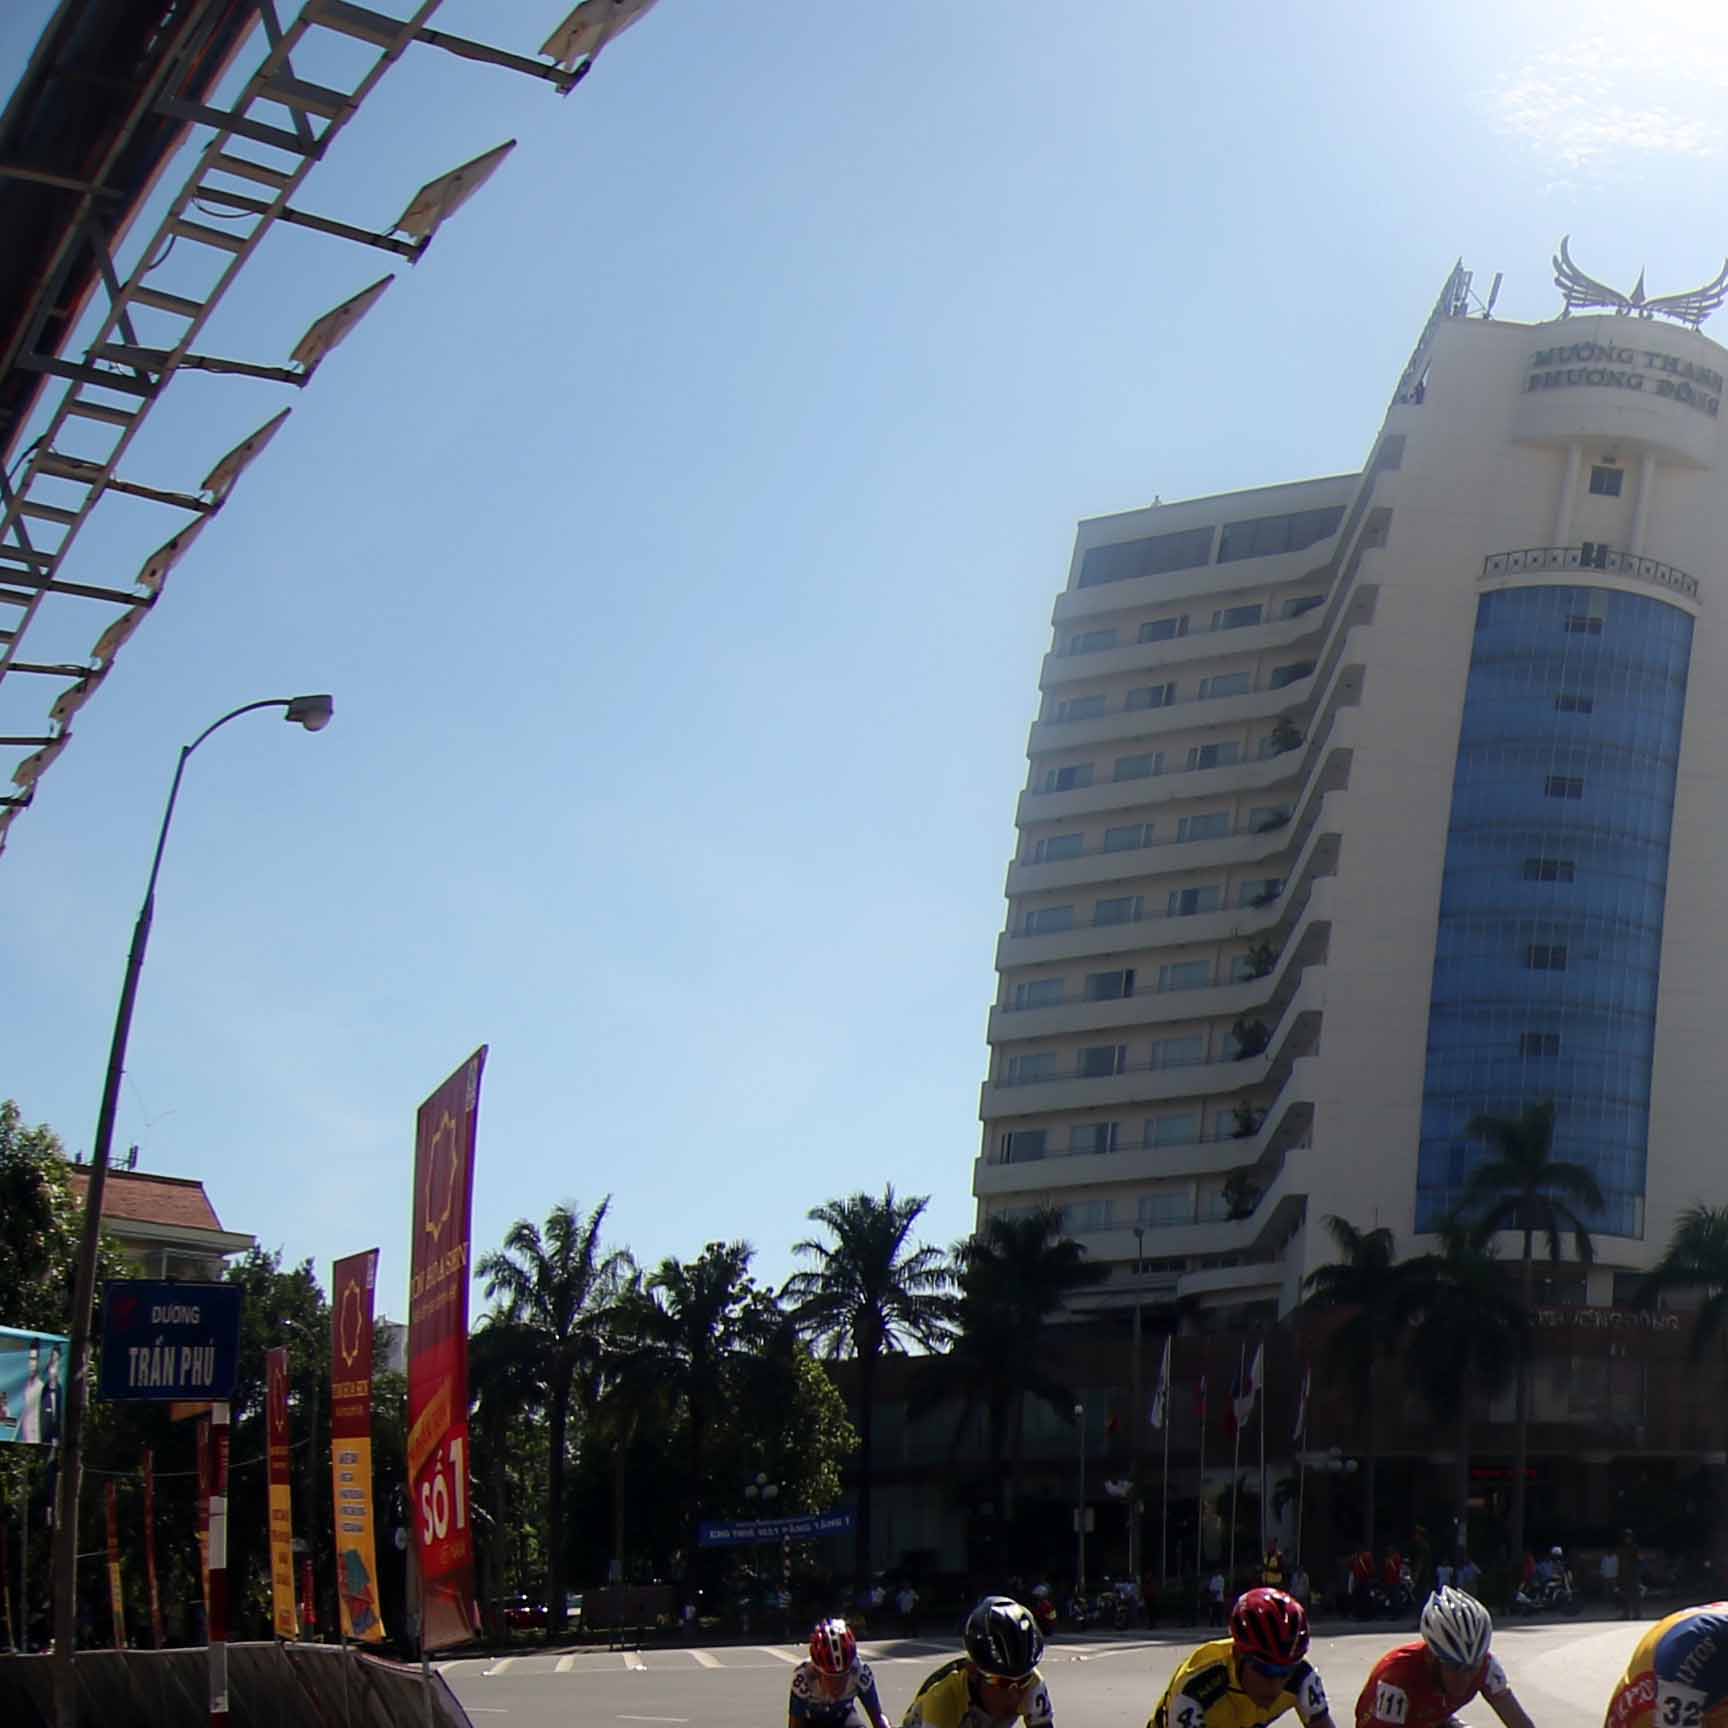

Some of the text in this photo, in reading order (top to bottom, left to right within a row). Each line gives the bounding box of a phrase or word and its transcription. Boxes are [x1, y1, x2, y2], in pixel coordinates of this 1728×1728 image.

[180, 1337, 215, 1387] PHÚ
[448, 1437, 466, 1530] 1
[1663, 1696, 1701, 1728] 32
